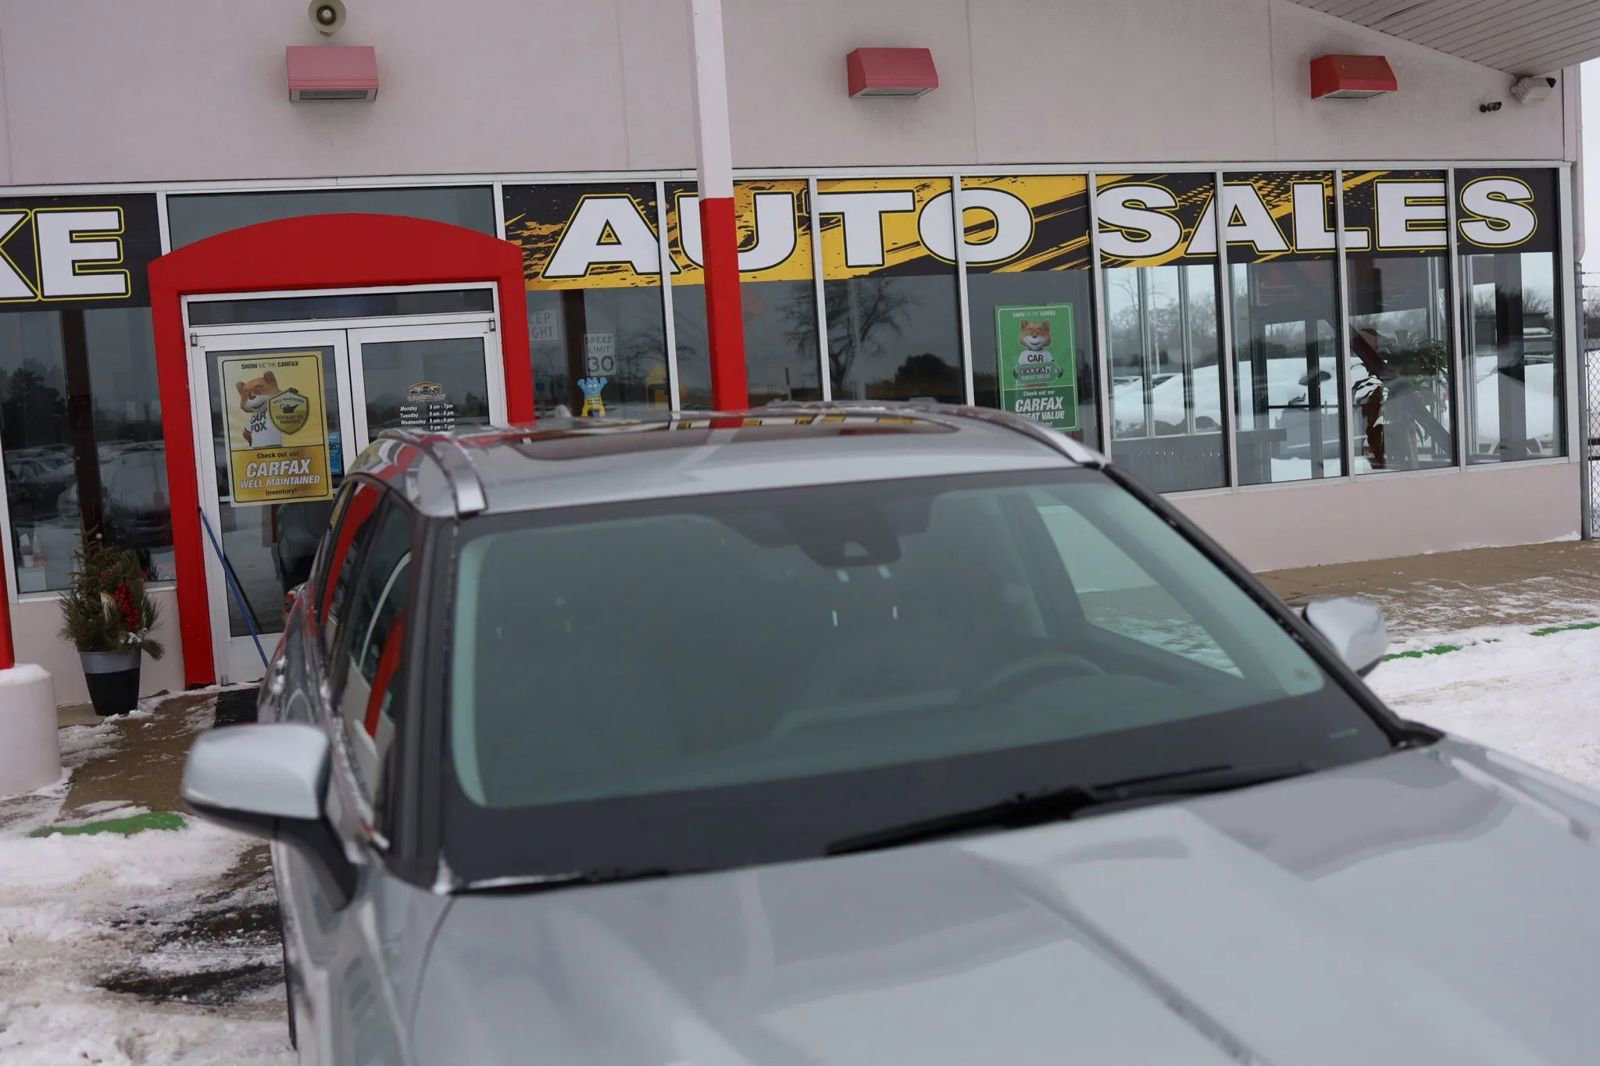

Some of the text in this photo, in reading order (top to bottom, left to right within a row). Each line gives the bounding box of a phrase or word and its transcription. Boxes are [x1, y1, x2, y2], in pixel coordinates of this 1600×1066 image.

[541, 187, 1035, 279] AUTO
[1096, 175, 1538, 259] SALES
[585, 336, 613, 345] SPEED
[588, 345, 610, 353] LIMIT
[587, 355, 614, 372] 30
[1027, 354, 1044, 363] CAR
[1015, 396, 1064, 413] CARFAX
[251, 411, 266, 424] CAR
[1041, 410, 1065, 420] VALUE
[250, 421, 267, 433] FOX
[257, 451, 276, 459] Check
[246, 458, 310, 478] CARFAX
[239, 475, 320, 490] WELL MAINTAINED
